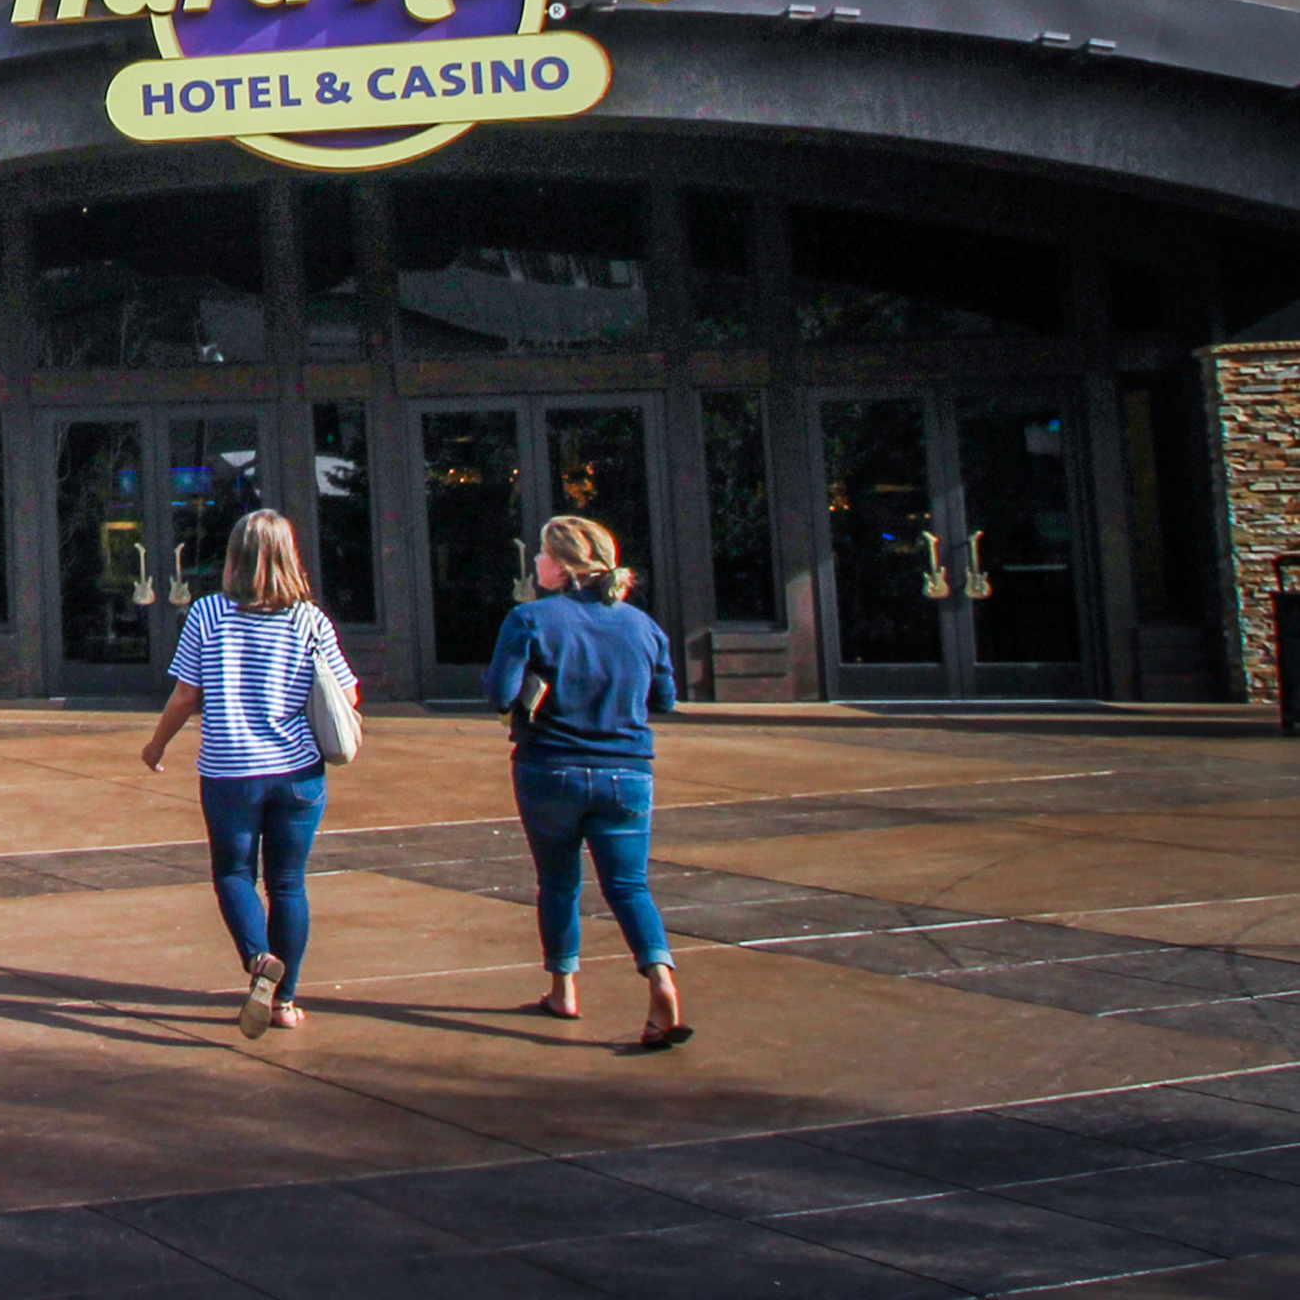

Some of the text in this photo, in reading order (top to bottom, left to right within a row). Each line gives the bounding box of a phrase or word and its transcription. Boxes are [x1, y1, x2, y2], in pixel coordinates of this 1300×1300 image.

[141, 56, 570, 116] HOTEL & CASINO
